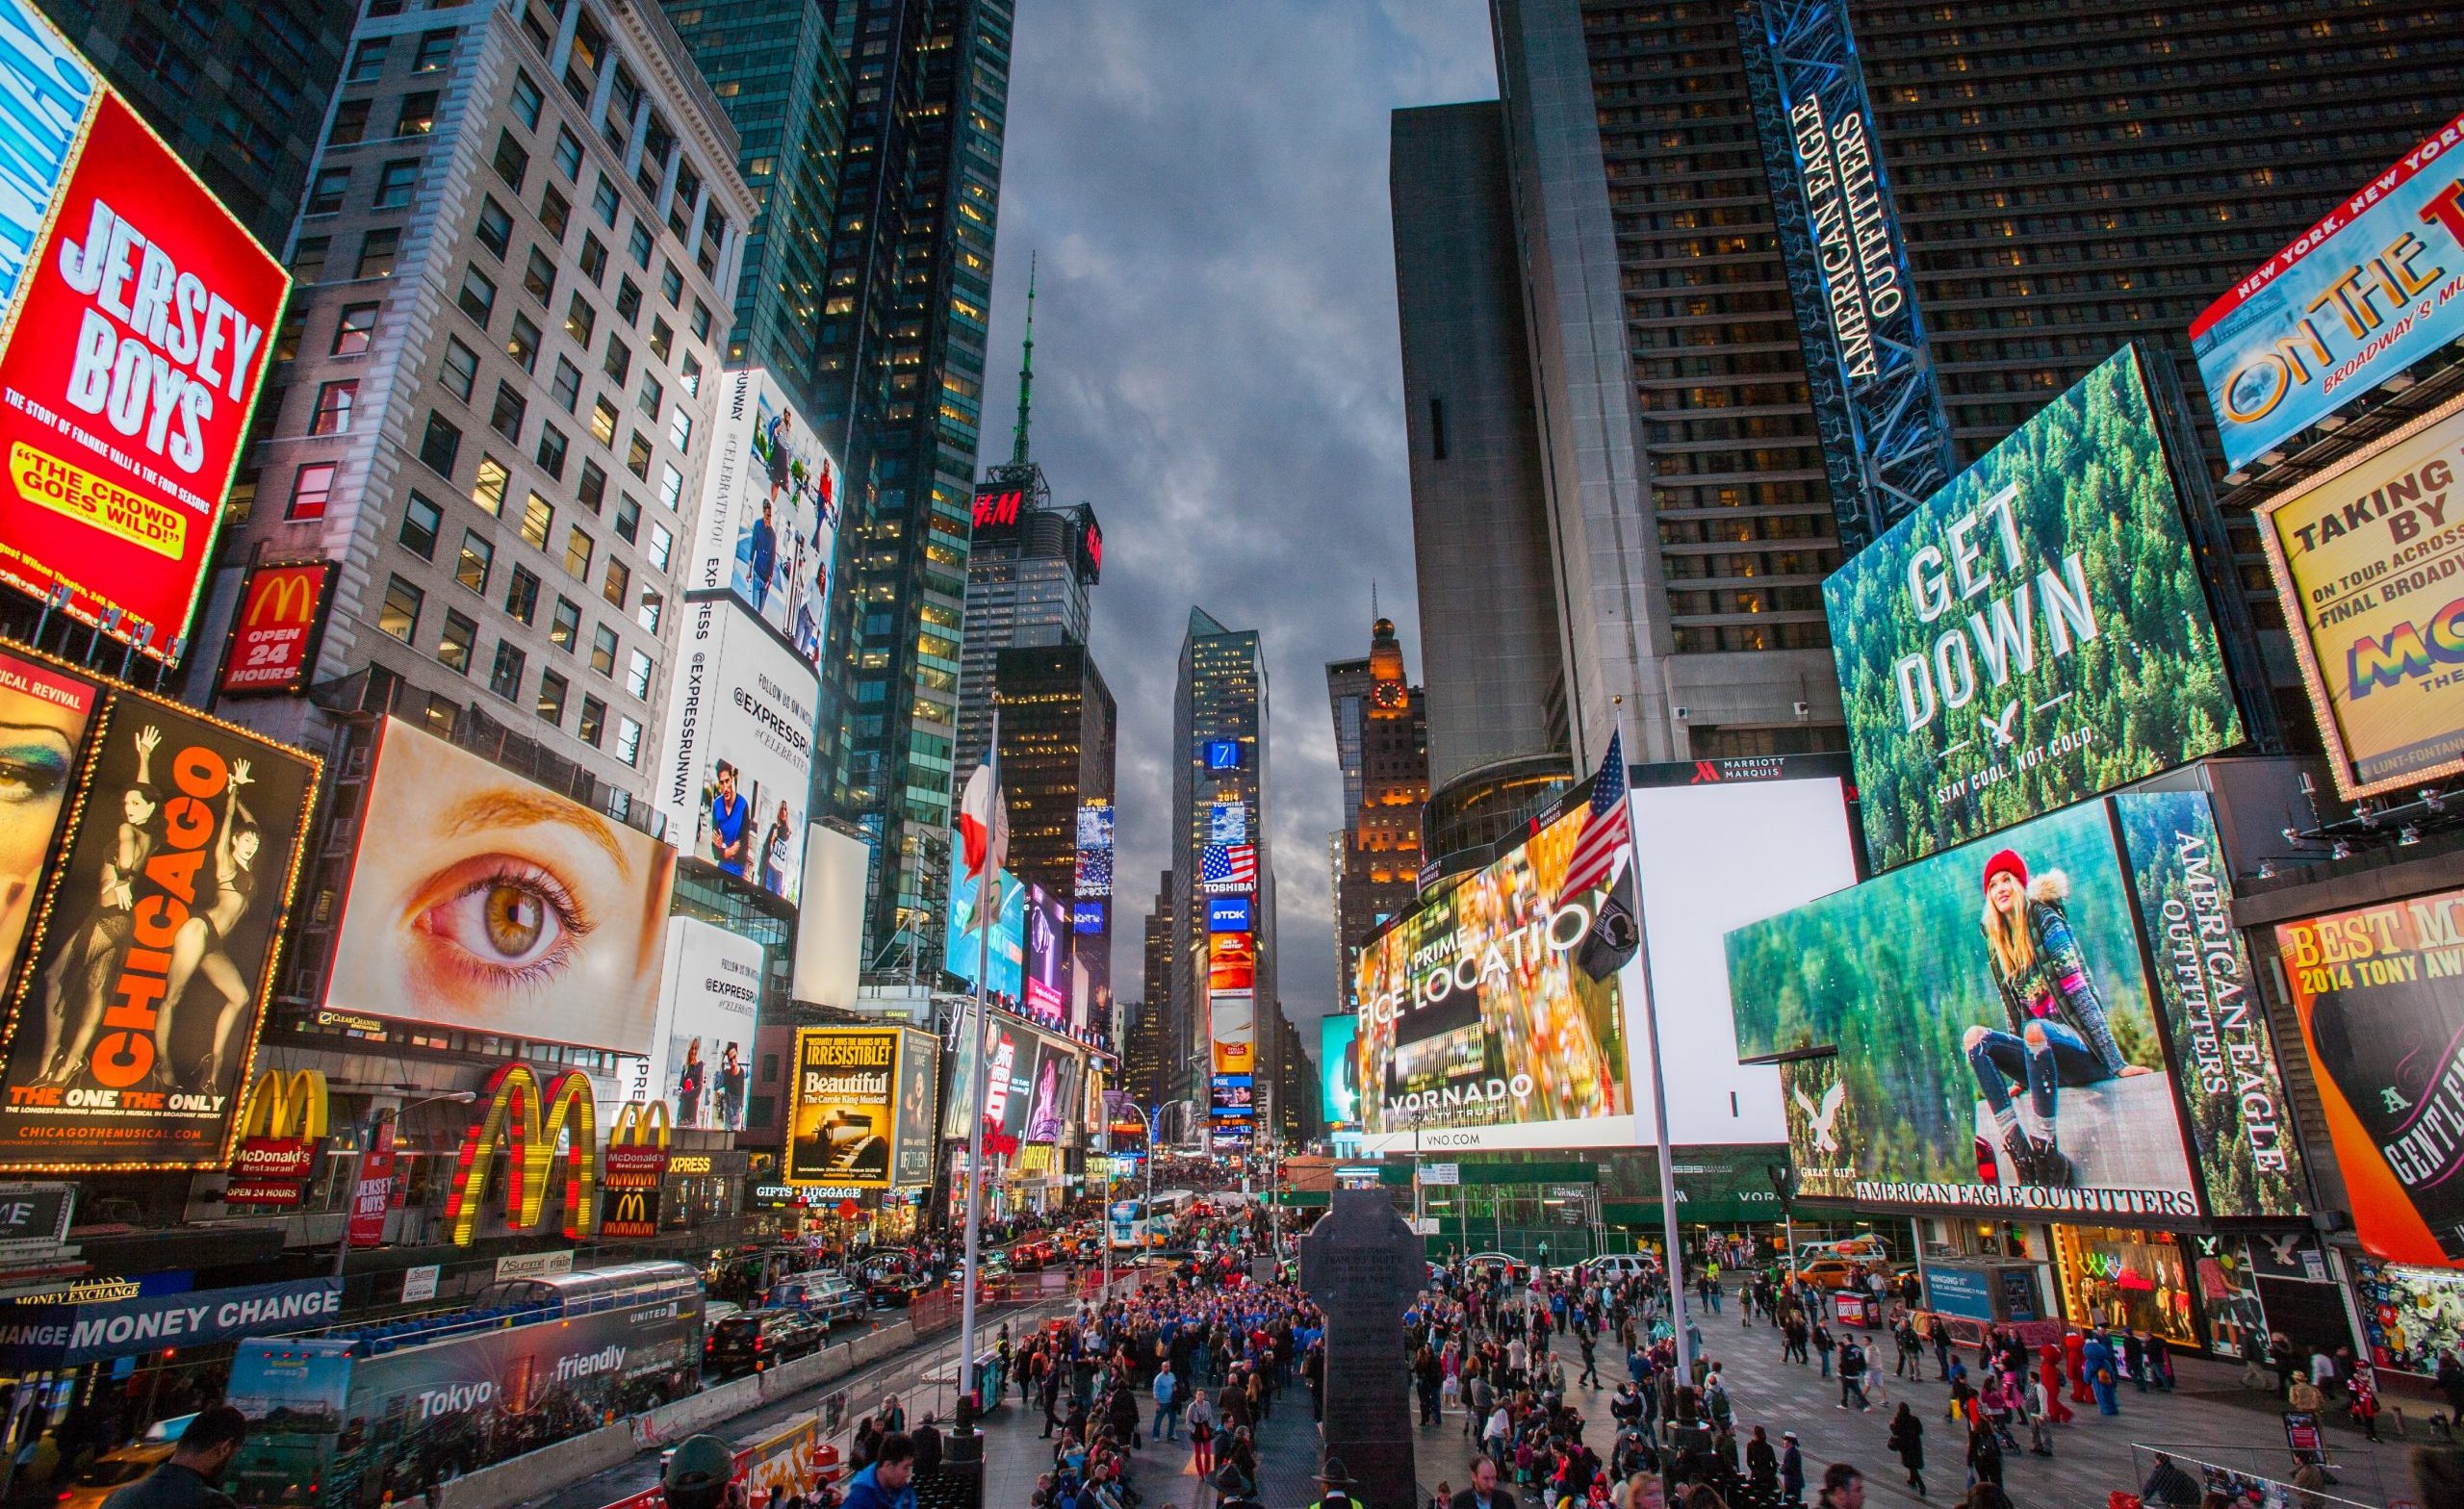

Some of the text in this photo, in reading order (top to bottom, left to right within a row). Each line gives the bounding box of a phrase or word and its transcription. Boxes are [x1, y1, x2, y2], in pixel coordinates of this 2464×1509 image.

[1833, 112, 1902, 318] OUTFITTERS
[1791, 93, 1877, 378] AMERICAN EAGLE
[2238, 262, 2275, 299] NEW
[2280, 217, 2344, 263] YORK,
[2349, 169, 2398, 214] NEW
[59, 198, 262, 403] JERSEY
[2221, 231, 2447, 423] ON THE
[2322, 299, 2432, 396] BROADWAY'S
[66, 308, 213, 473] BOYS
[732, 369, 749, 421] RUNWAY
[5, 386, 211, 516] THE STORY OF FRANKIE VALLI & THE FOUR SEASONS
[22, 471, 97, 513] GOES
[91, 481, 177, 530] CROWD
[710, 433, 738, 547] #CELEBRATEYOU
[2294, 458, 2454, 552] TAKING
[2388, 492, 2448, 546] BY
[1908, 482, 2023, 624] GET
[22, 553, 106, 605] Wilson Theatre, 245
[705, 558, 719, 588] EXP
[2312, 580, 2334, 603] ON
[2343, 560, 2387, 591] TOUR
[2319, 590, 2378, 630] FINAL
[248, 627, 300, 643] OPEN
[1894, 551, 2098, 733] DOWN
[247, 644, 291, 666] 24
[230, 665, 297, 684] HOURS
[32, 681, 81, 710] REVIVAL
[757, 673, 800, 715] FOLLOW US ON
[673, 652, 706, 806] @EXPRESSRUNWAY
[1724, 757, 1784, 769] MARRIOTT
[1725, 768, 1780, 779] MARQUIS
[1938, 727, 2099, 805] STAY COOL. NOT COLD.
[1218, 793, 1239, 802] 2014
[1539, 800, 1563, 819] MARRIOTT
[1540, 810, 1561, 829] MARQUIS
[1205, 882, 1253, 893] TOSHIBA
[90, 746, 228, 1087] CHICAGO
[1220, 910, 1245, 920] TDK
[1413, 926, 1468, 971] PRIME
[1414, 901, 1596, 1010] LOCATIO
[2287, 909, 2400, 968] BEST
[2299, 955, 2418, 995] 2014 TONY
[2161, 899, 2228, 1096] OUTFITTERS
[2175, 830, 2288, 1172] AMERICAN EAGLE
[10, 1087, 225, 1112] THE ONE THE ONLY
[806, 1072, 888, 1093] Beautiful
[1389, 1074, 1533, 1115] VORNADO
[2380, 1087, 2412, 1113] A
[20, 1106, 89, 1115] LONGEST-RUNNING
[805, 1095, 886, 1106] The Carole King Musical
[1456, 1106, 1508, 1119] TRUST
[19, 1127, 201, 1139] CHICAGOTHEMUSICAL.COM
[1427, 1135, 1480, 1145] VNO.COM
[234, 1146, 310, 1163] McDonald's
[242, 1164, 295, 1173] Restaurant
[608, 1153, 664, 1163] McDonald's
[901, 1152, 928, 1169] IF/THEN
[1022, 1145, 1050, 1170] FOREVER
[227, 1188, 297, 1198] OPEN 24 HOURS
[357, 1177, 393, 1198] JERSEY
[360, 1194, 386, 1215] BOYS
[757, 1187, 860, 1198] GIFTS LUGGAGE
[1858, 1183, 2196, 1215] AMERICAN EAGLE OUTFITTERS
[509, 1259, 544, 1269] Summit
[15, 1283, 140, 1305] MONEY EXCHANGE
[70, 1291, 342, 1349] MONEY CHANGE
[630, 1308, 667, 1323] UNITED
[556, 1345, 626, 1383] friendly
[419, 1381, 493, 1419] Tokyo
